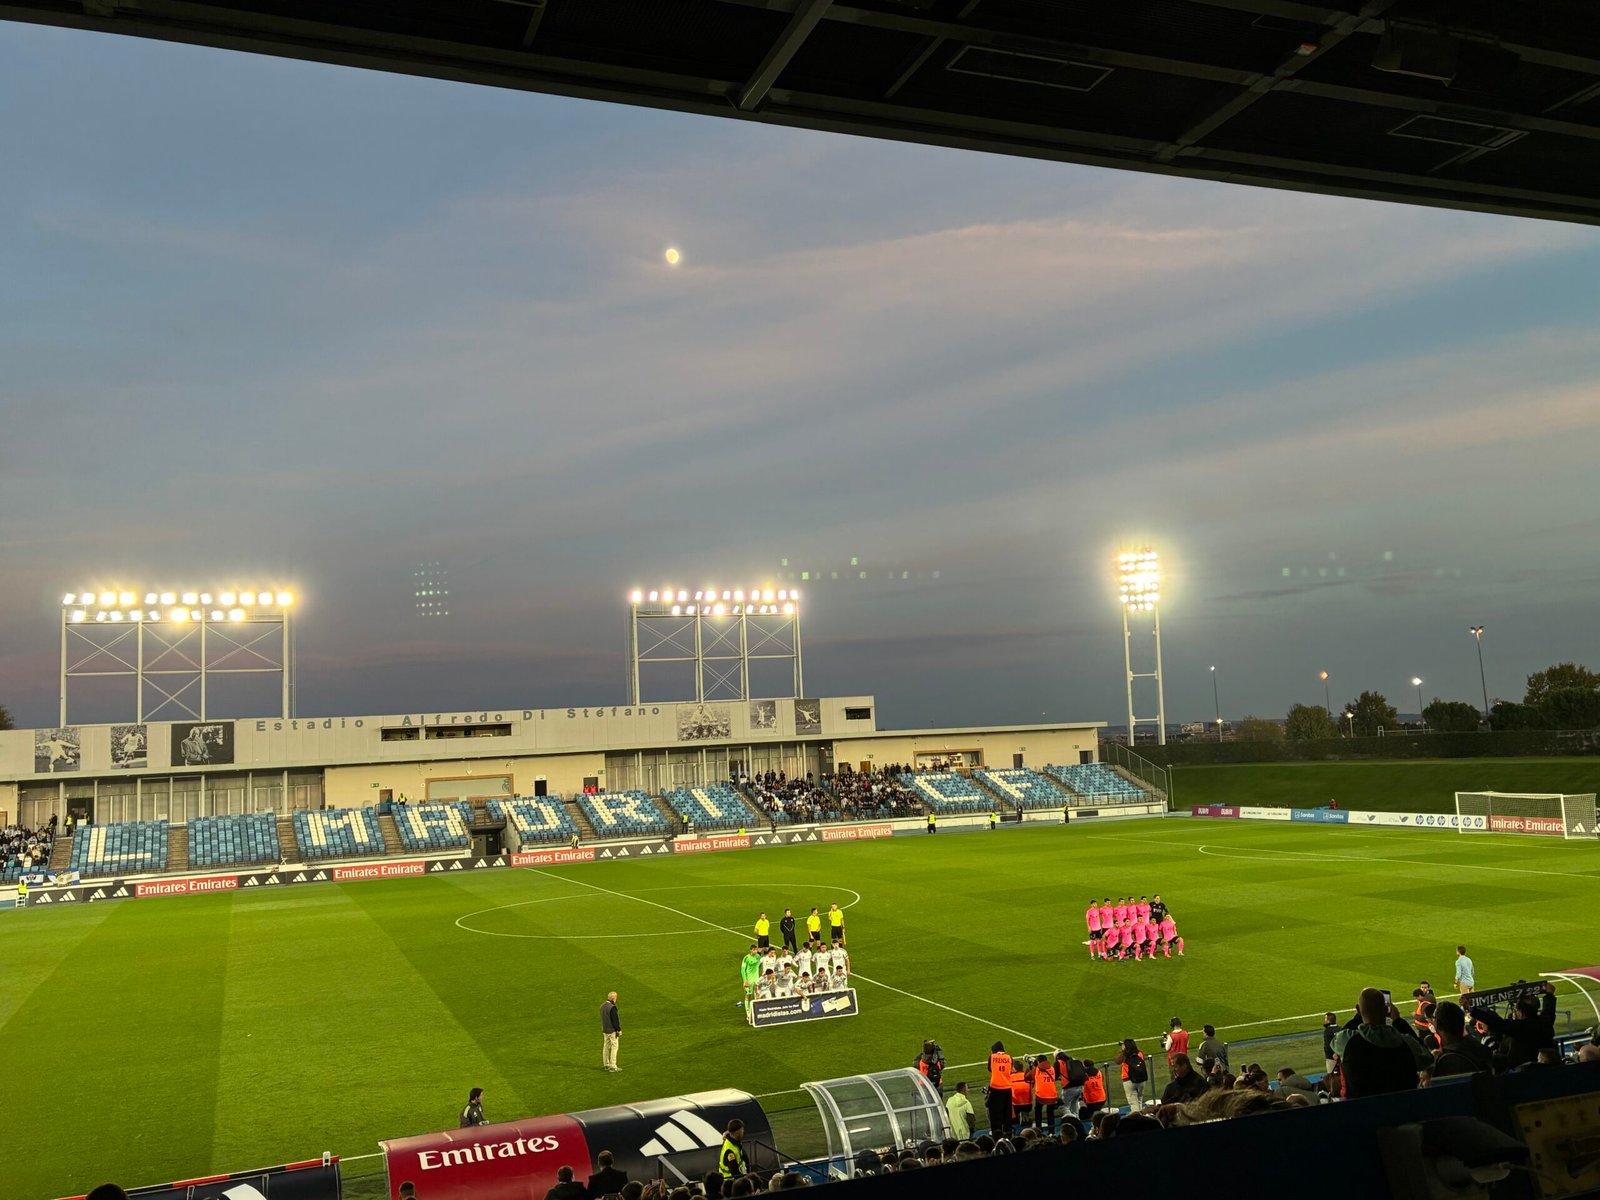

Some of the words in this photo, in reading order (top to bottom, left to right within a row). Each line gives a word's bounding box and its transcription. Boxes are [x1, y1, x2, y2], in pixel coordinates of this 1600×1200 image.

[256, 718, 364, 731] Estadio
[402, 712, 503, 726] Alfredo
[523, 710, 545, 720] Di
[567, 706, 660, 719] Stéfano
[823, 829, 857, 839] Emirates
[858, 826, 892, 837] Emirates
[1525, 820, 1565, 831] Emirates
[674, 841, 711, 852] Emirates
[713, 838, 749, 848] Emirates
[512, 854, 553, 865] Emirates
[554, 850, 594, 861] Emirates
[334, 868, 379, 879] Emirates
[381, 864, 424, 875] Emirates
[138, 883, 186, 895] Emirates
[189, 879, 237, 891] Emirates
[417, 1135, 560, 1171] Emirates
